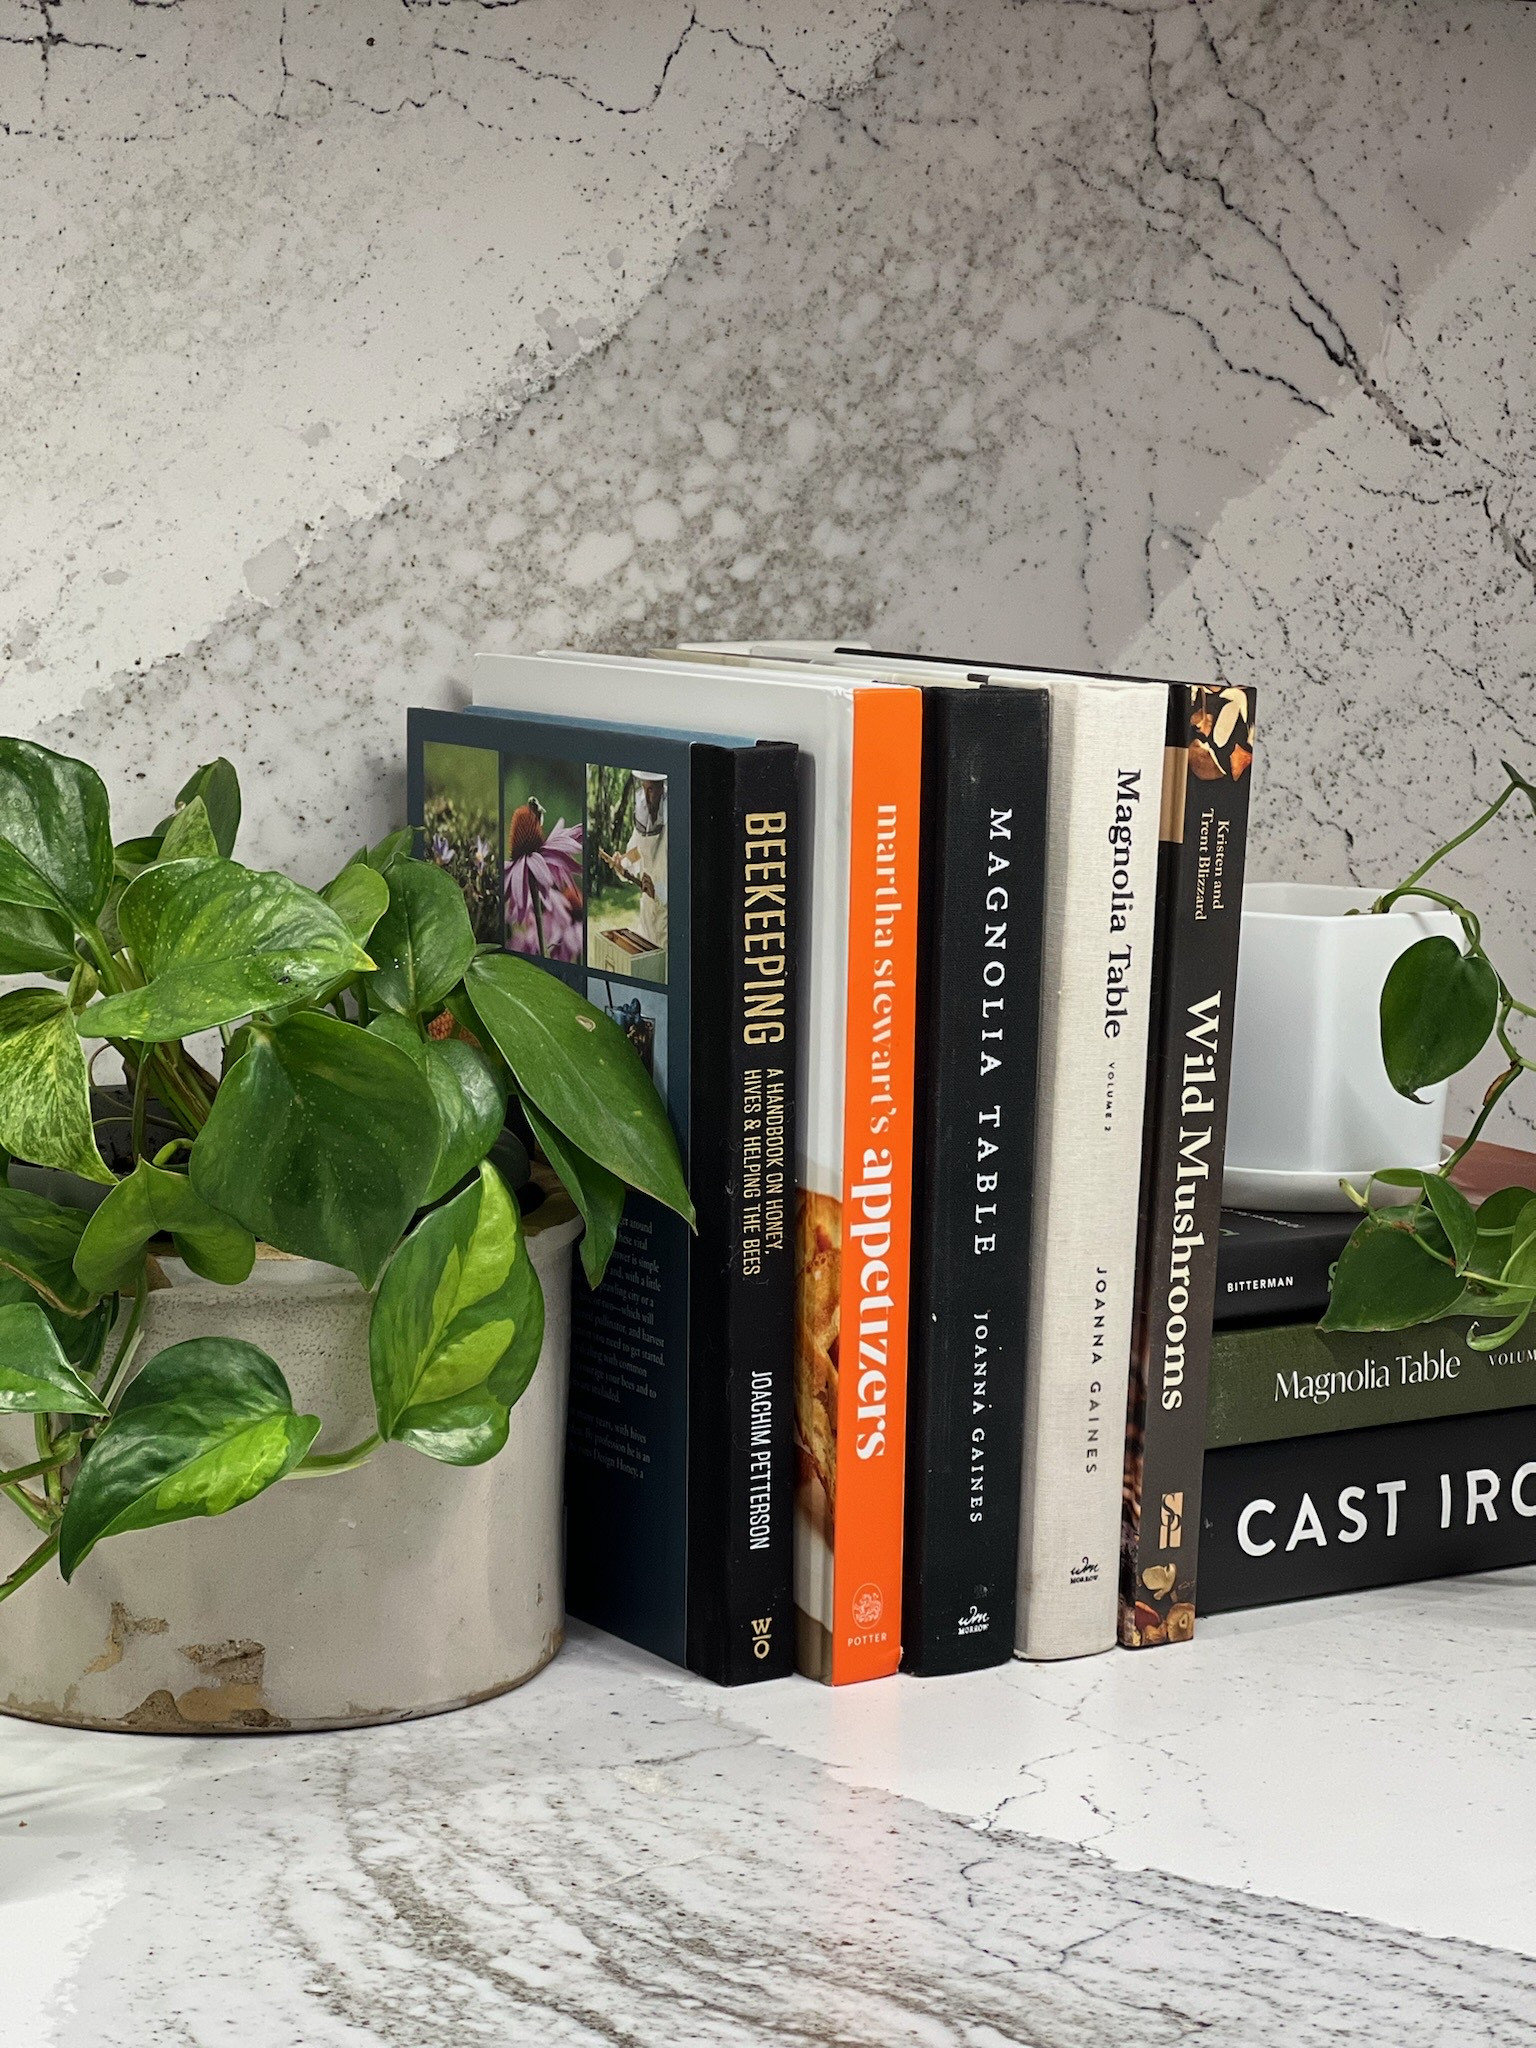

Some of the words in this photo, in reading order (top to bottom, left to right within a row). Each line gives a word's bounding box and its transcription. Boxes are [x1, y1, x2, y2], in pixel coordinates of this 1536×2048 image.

[1109, 769, 1141, 933] Magnolia
[1199, 808, 1214, 852] Trent
[1215, 821, 1229, 876] Kristen
[875, 805, 902, 947] martha
[1195, 857, 1211, 920] Blizzard
[1213, 881, 1224, 909] and
[744, 812, 788, 1044] BEEKEEPING
[980, 808, 1012, 1076] MAGNOLIA
[1105, 944, 1132, 1038] Table
[767, 1069, 783, 1078] A
[871, 959, 896, 1133] stewart's
[1181, 990, 1221, 1116] Wild
[744, 1070, 761, 1113] HIVES
[1106, 1062, 1114, 1118] VOLUME
[744, 1120, 761, 1131] &
[766, 1083, 784, 1167] HANDBOOK
[744, 1136, 761, 1198] HELPING
[766, 1173, 783, 1194] ON
[975, 1105, 1000, 1254] TABLE
[744, 1204, 761, 1233] THE
[765, 1199, 783, 1254] HONEY,
[625, 1271, 639, 1284] with
[743, 1239, 760, 1275] BEES
[1162, 1126, 1212, 1410] Mushrooms
[1228, 1277, 1293, 1292] BITTERMAN
[629, 1327, 640, 1338] and
[642, 1312, 654, 1325] will
[850, 1149, 894, 1459] appetizers
[1092, 1267, 1107, 1364] JOANNA
[631, 1347, 640, 1358] get
[973, 1313, 988, 1414] JOANNA
[1275, 1359, 1389, 1404] Magnolia
[1396, 1348, 1460, 1384] Table
[636, 1384, 648, 1396] and
[751, 1371, 772, 1446] JOACHIM
[1086, 1381, 1101, 1473] GAINES
[750, 1451, 771, 1549] PETTERSON
[970, 1428, 985, 1522] GAINES
[1238, 1480, 1406, 1556] CAST
[847, 1631, 888, 1647] POTTER
